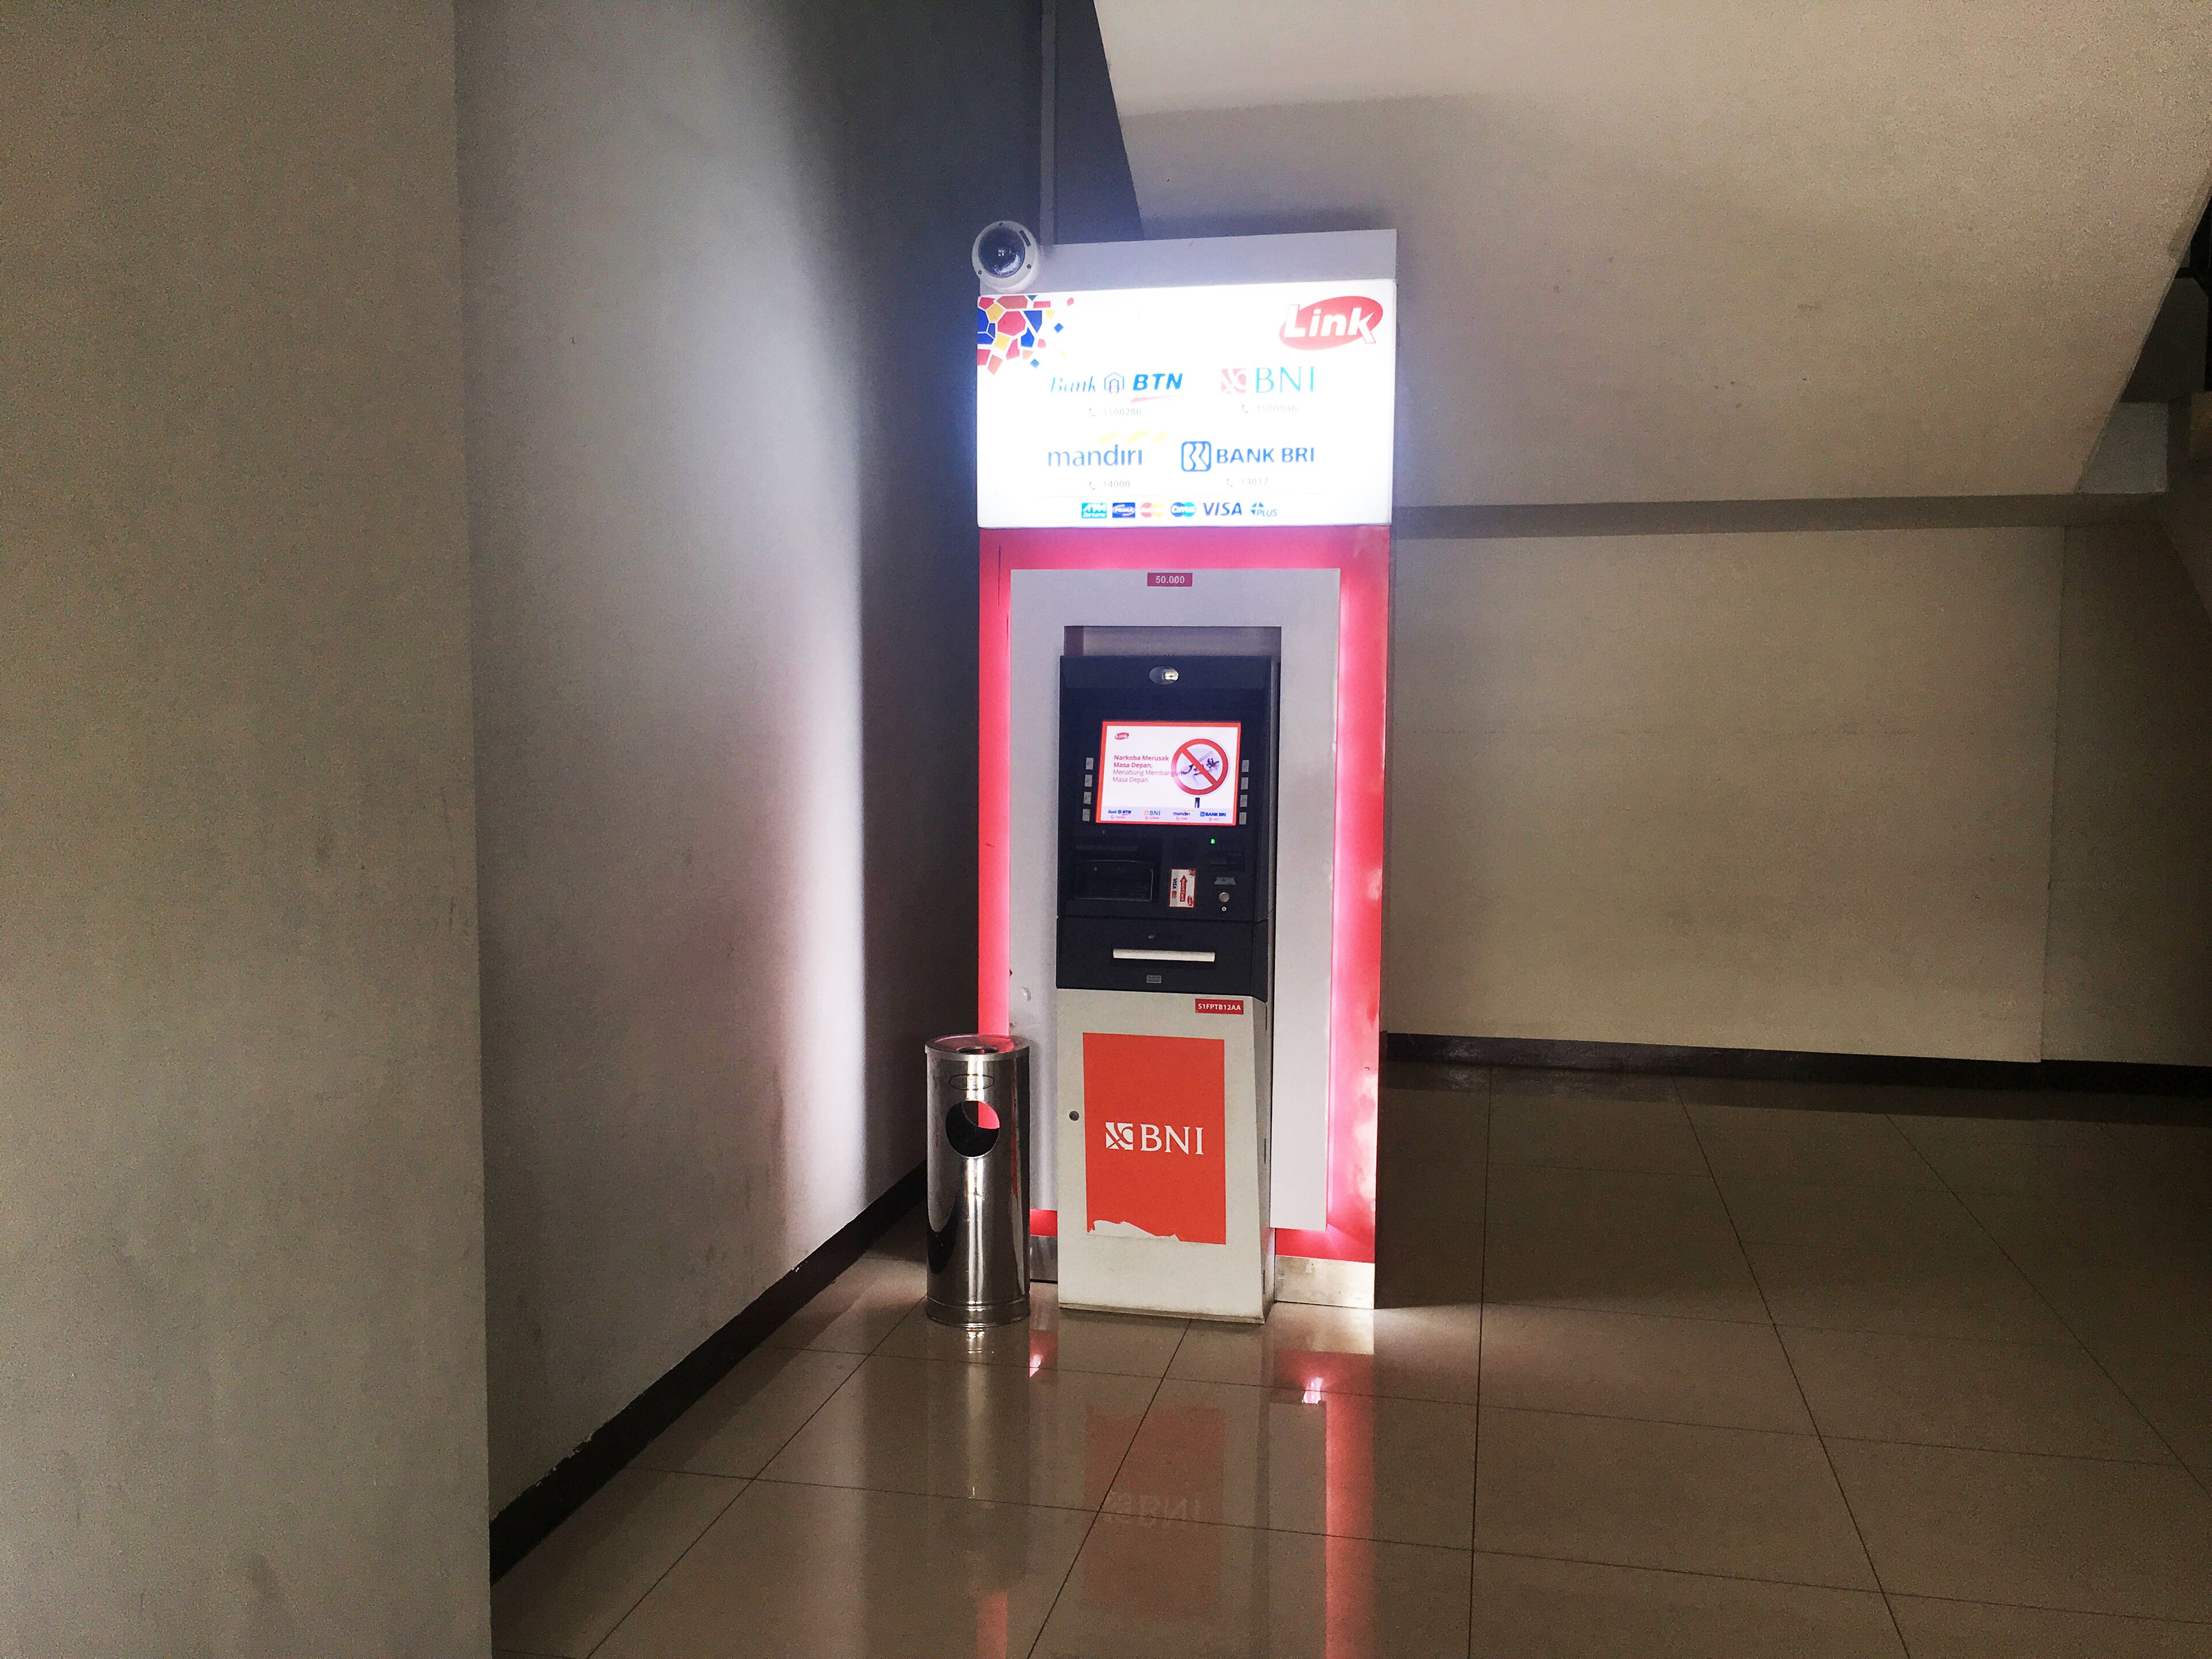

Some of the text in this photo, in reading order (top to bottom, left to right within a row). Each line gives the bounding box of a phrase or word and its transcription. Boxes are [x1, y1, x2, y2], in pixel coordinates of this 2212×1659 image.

[1283, 304, 1377, 344] Link
[1051, 373, 1183, 392] Bank BTN
[1255, 366, 1315, 393] BNI
[1104, 408, 1142, 416] 1500286
[1256, 404, 1297, 412] 1500046
[1048, 444, 1142, 467] mandiri
[1217, 448, 1314, 463] BANK BRI
[1103, 480, 1131, 488] 14000
[1203, 502, 1243, 516] VISA
[1256, 509, 1278, 517] PLUS
[1156, 575, 1185, 584] 50.000
[1198, 1003, 1241, 1011] S1FPTB12AA
[1139, 1124, 1204, 1155] BNI
